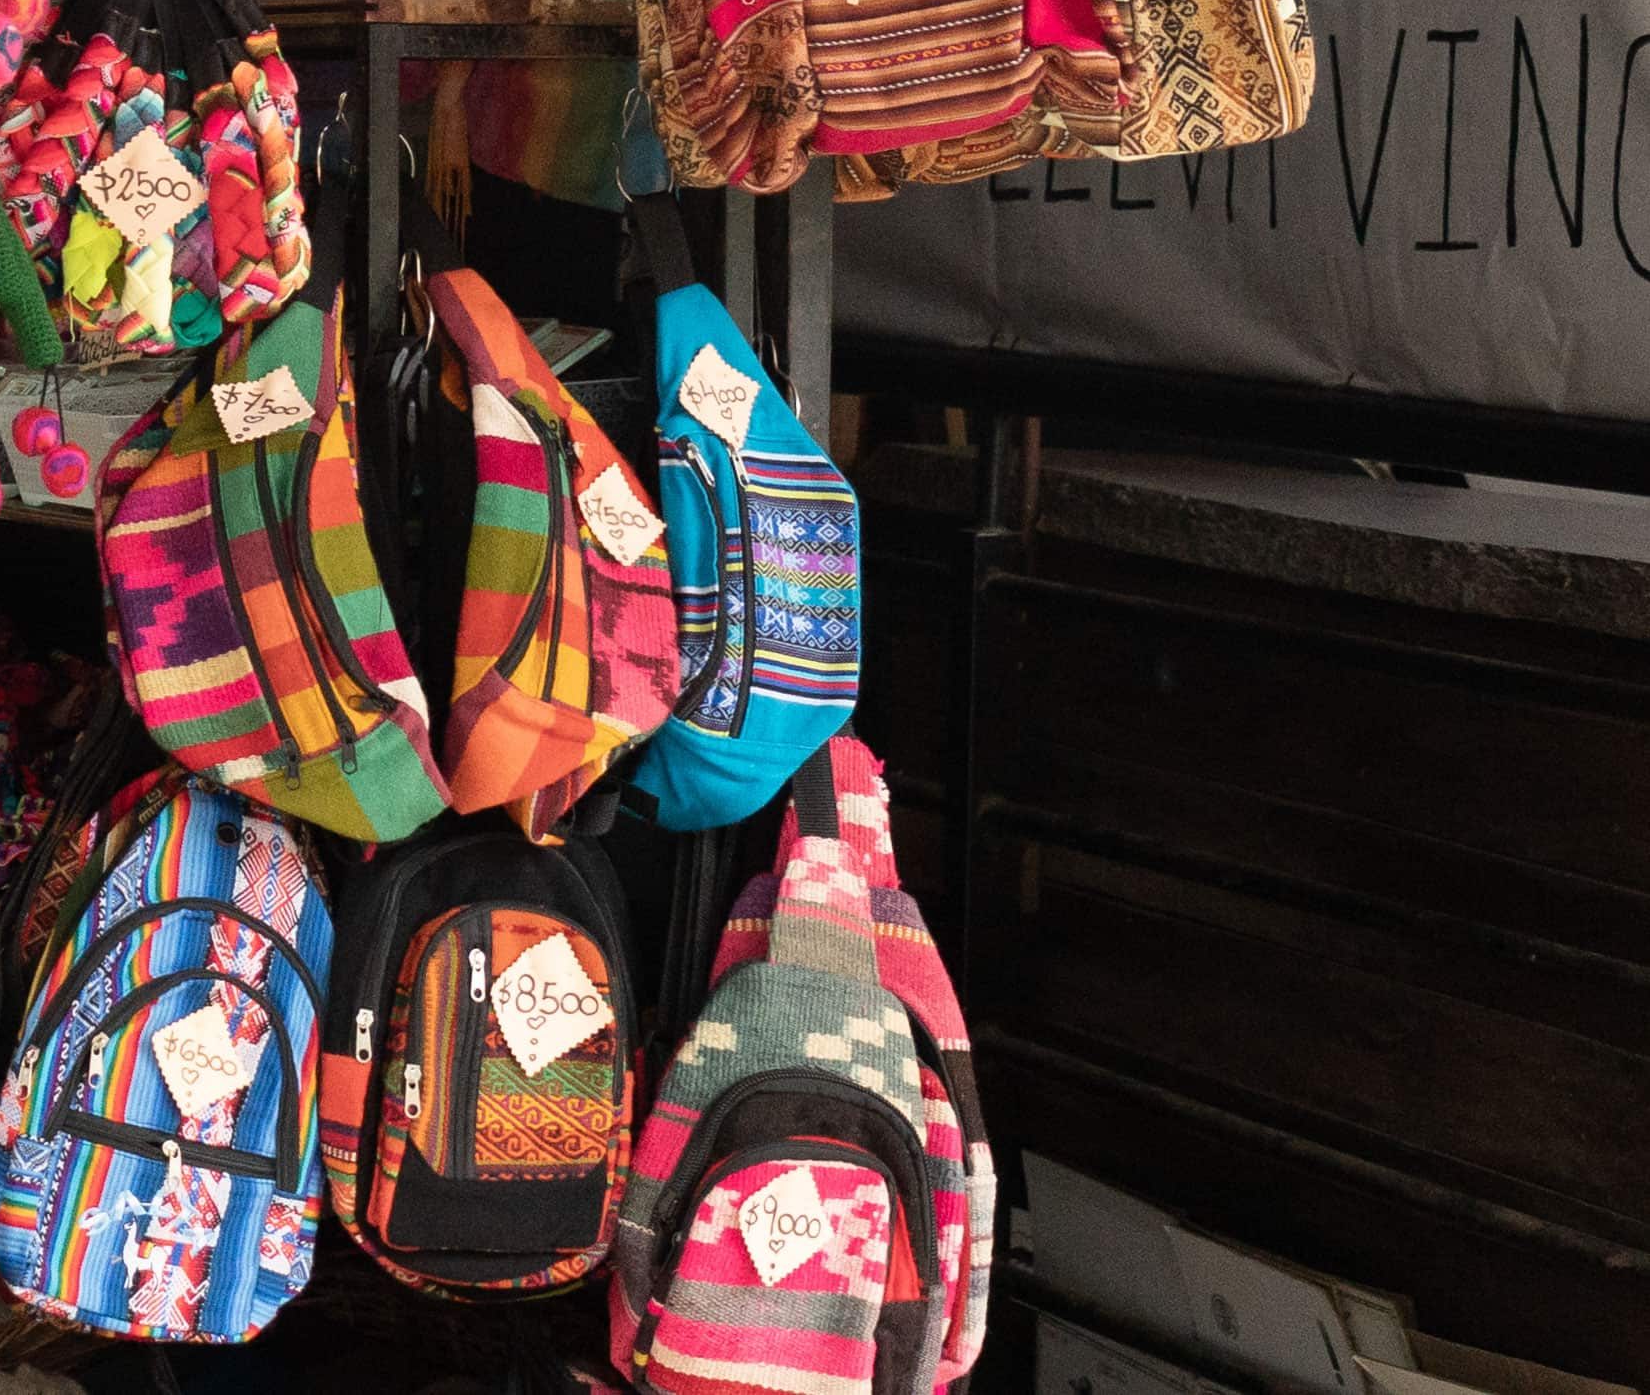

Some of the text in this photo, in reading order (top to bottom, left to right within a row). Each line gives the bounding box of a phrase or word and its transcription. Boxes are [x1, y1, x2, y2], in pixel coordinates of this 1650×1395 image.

[94, 166, 192, 203] $2500
[220, 386, 301, 415] $7500
[683, 378, 747, 412] $4000
[499, 973, 600, 1017] $8500
[163, 1029, 238, 1077] $6500
[744, 1194, 822, 1239] $9000
